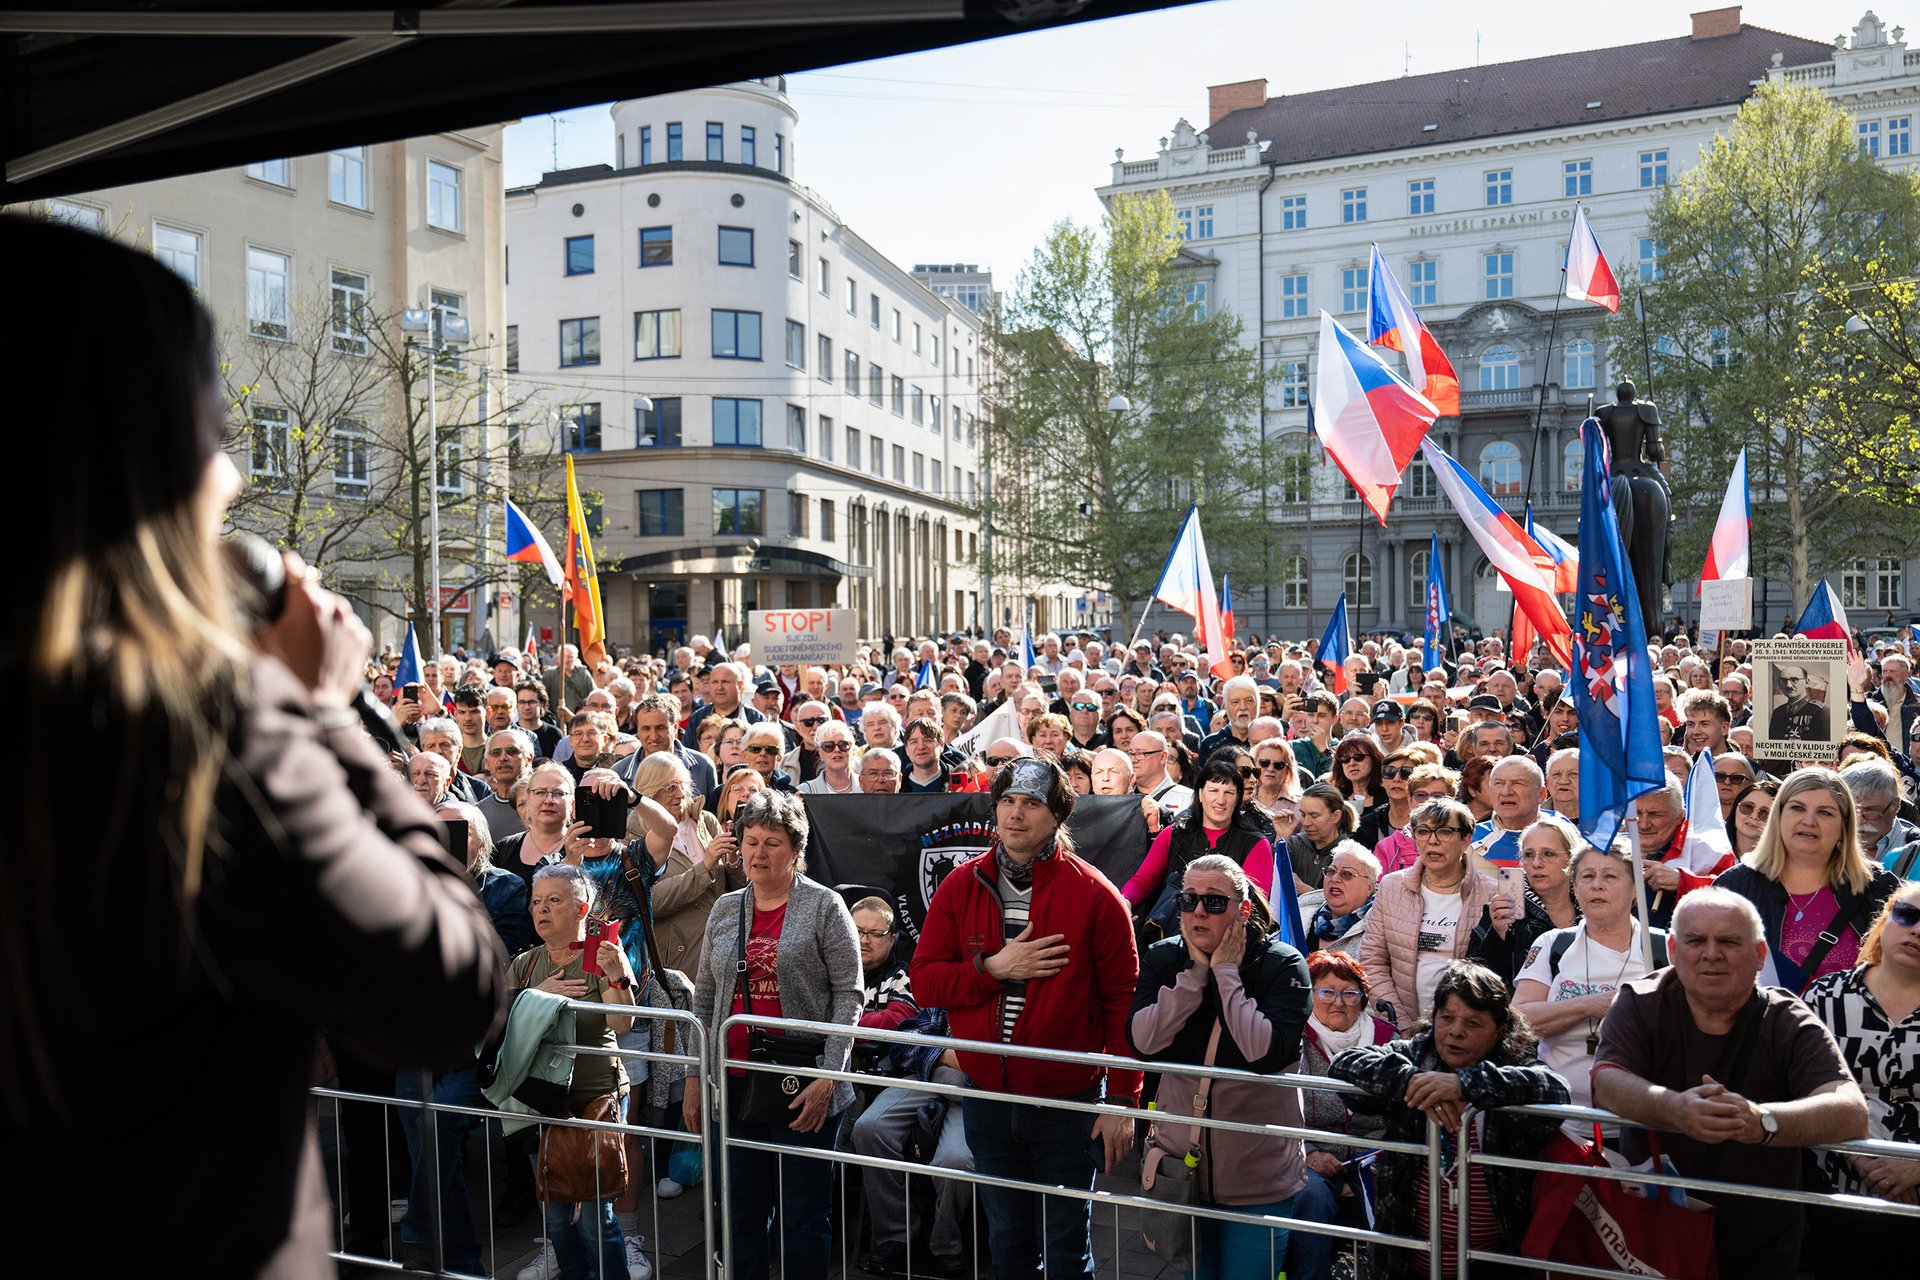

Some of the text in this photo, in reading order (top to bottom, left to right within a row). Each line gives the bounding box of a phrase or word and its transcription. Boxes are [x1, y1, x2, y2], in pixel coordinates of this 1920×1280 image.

[1410, 219, 1474, 236] NEJVYŠŠÍ
[1482, 210, 1543, 228] SPRÁVNÍ
[764, 611, 831, 633] STOP!
[1770, 750, 1787, 758] MOJÍ
[1788, 750, 1812, 758] ČESKÉ
[1826, 743, 1841, 751] SPÁ
